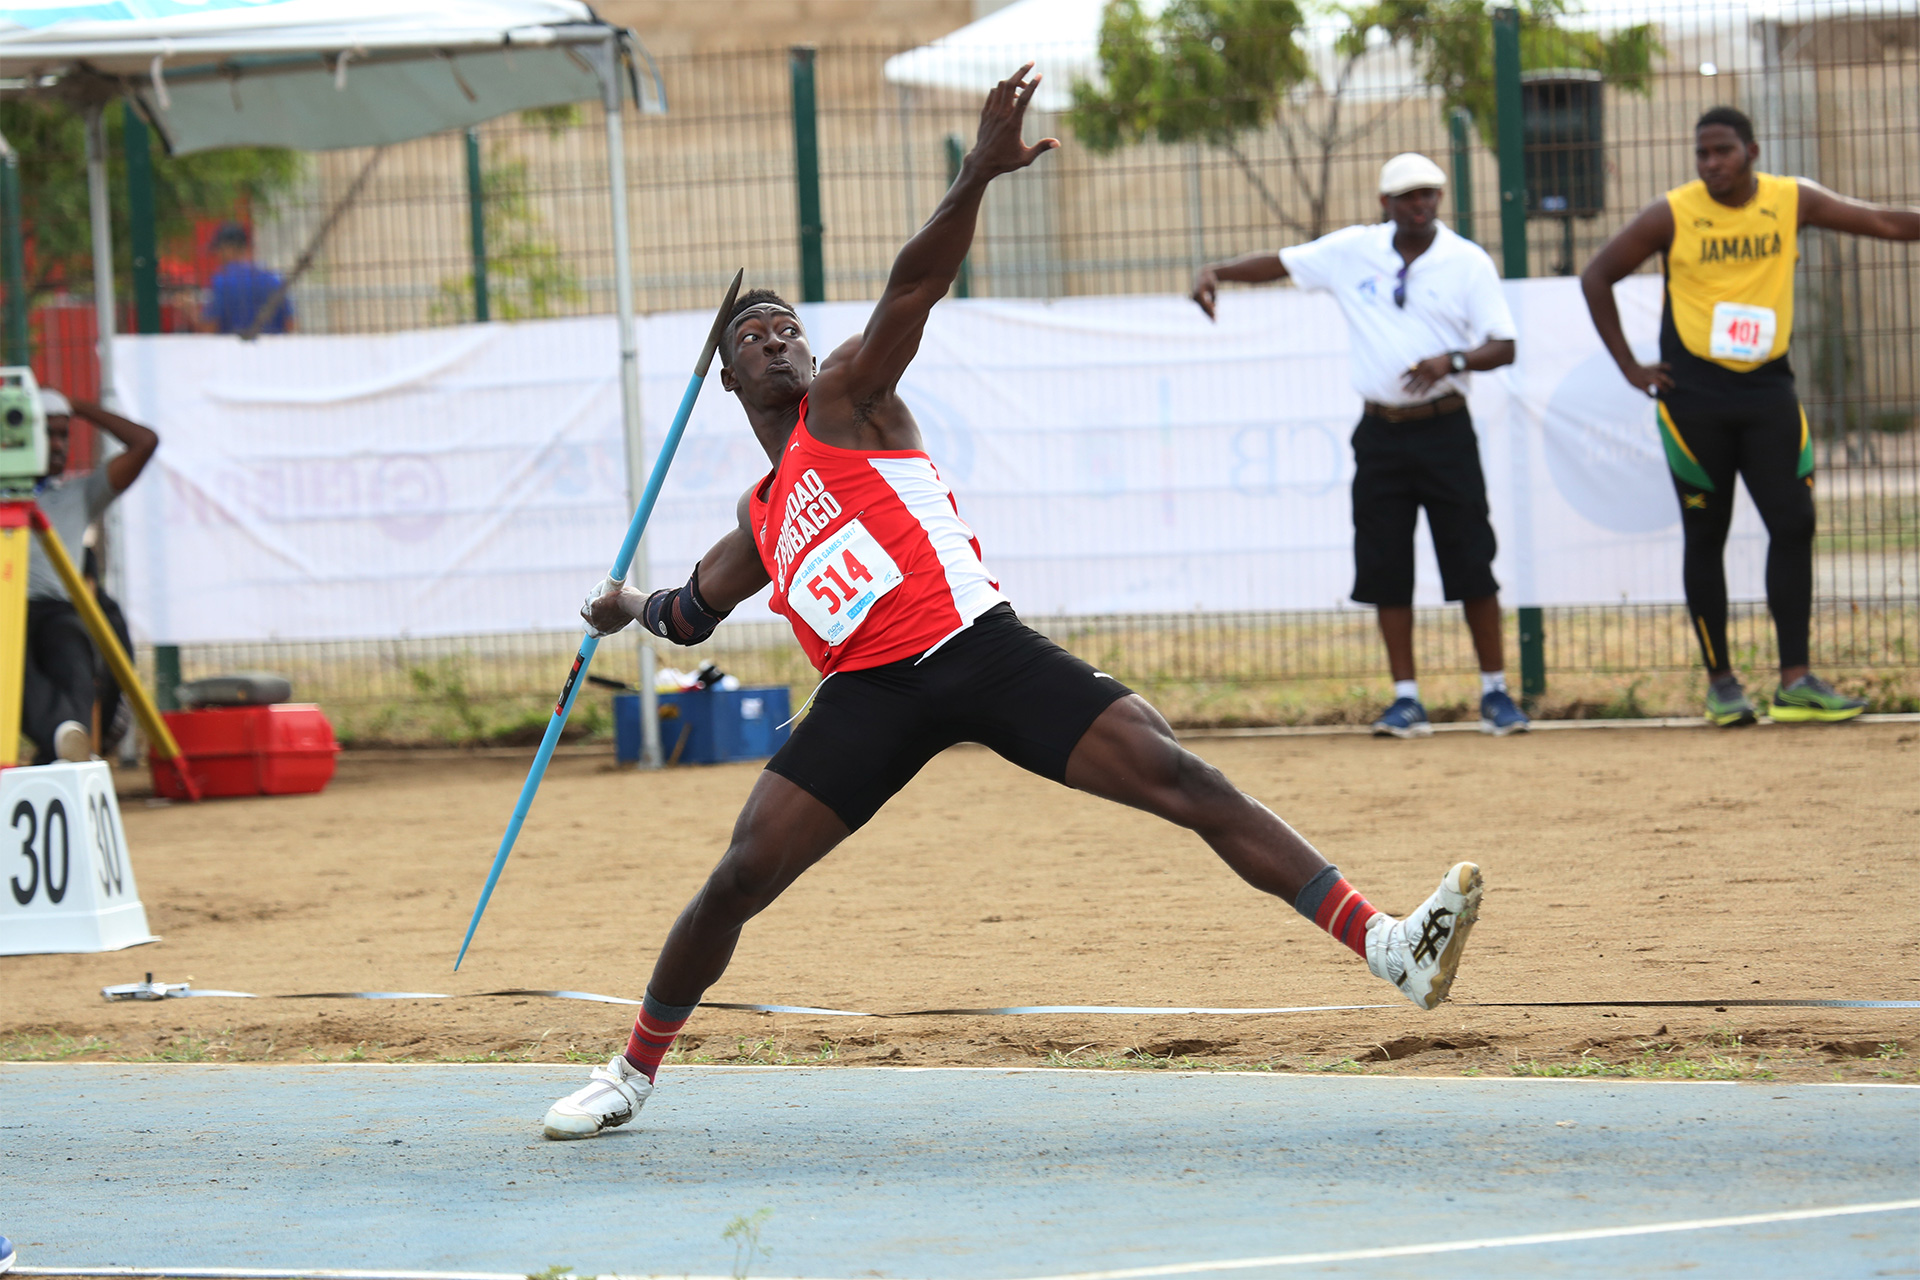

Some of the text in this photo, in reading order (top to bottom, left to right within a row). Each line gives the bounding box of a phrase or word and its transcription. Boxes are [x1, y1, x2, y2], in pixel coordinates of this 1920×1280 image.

[1700, 230, 1781, 263] JAMAICA
[1727, 318, 1760, 346] 401
[790, 527, 856, 593] FLOW CARIFTA GAMES 2017
[806, 549, 873, 615] 514
[827, 621, 841, 635] FLOW
[11, 798, 69, 905] 30
[88, 792, 123, 897] 30
